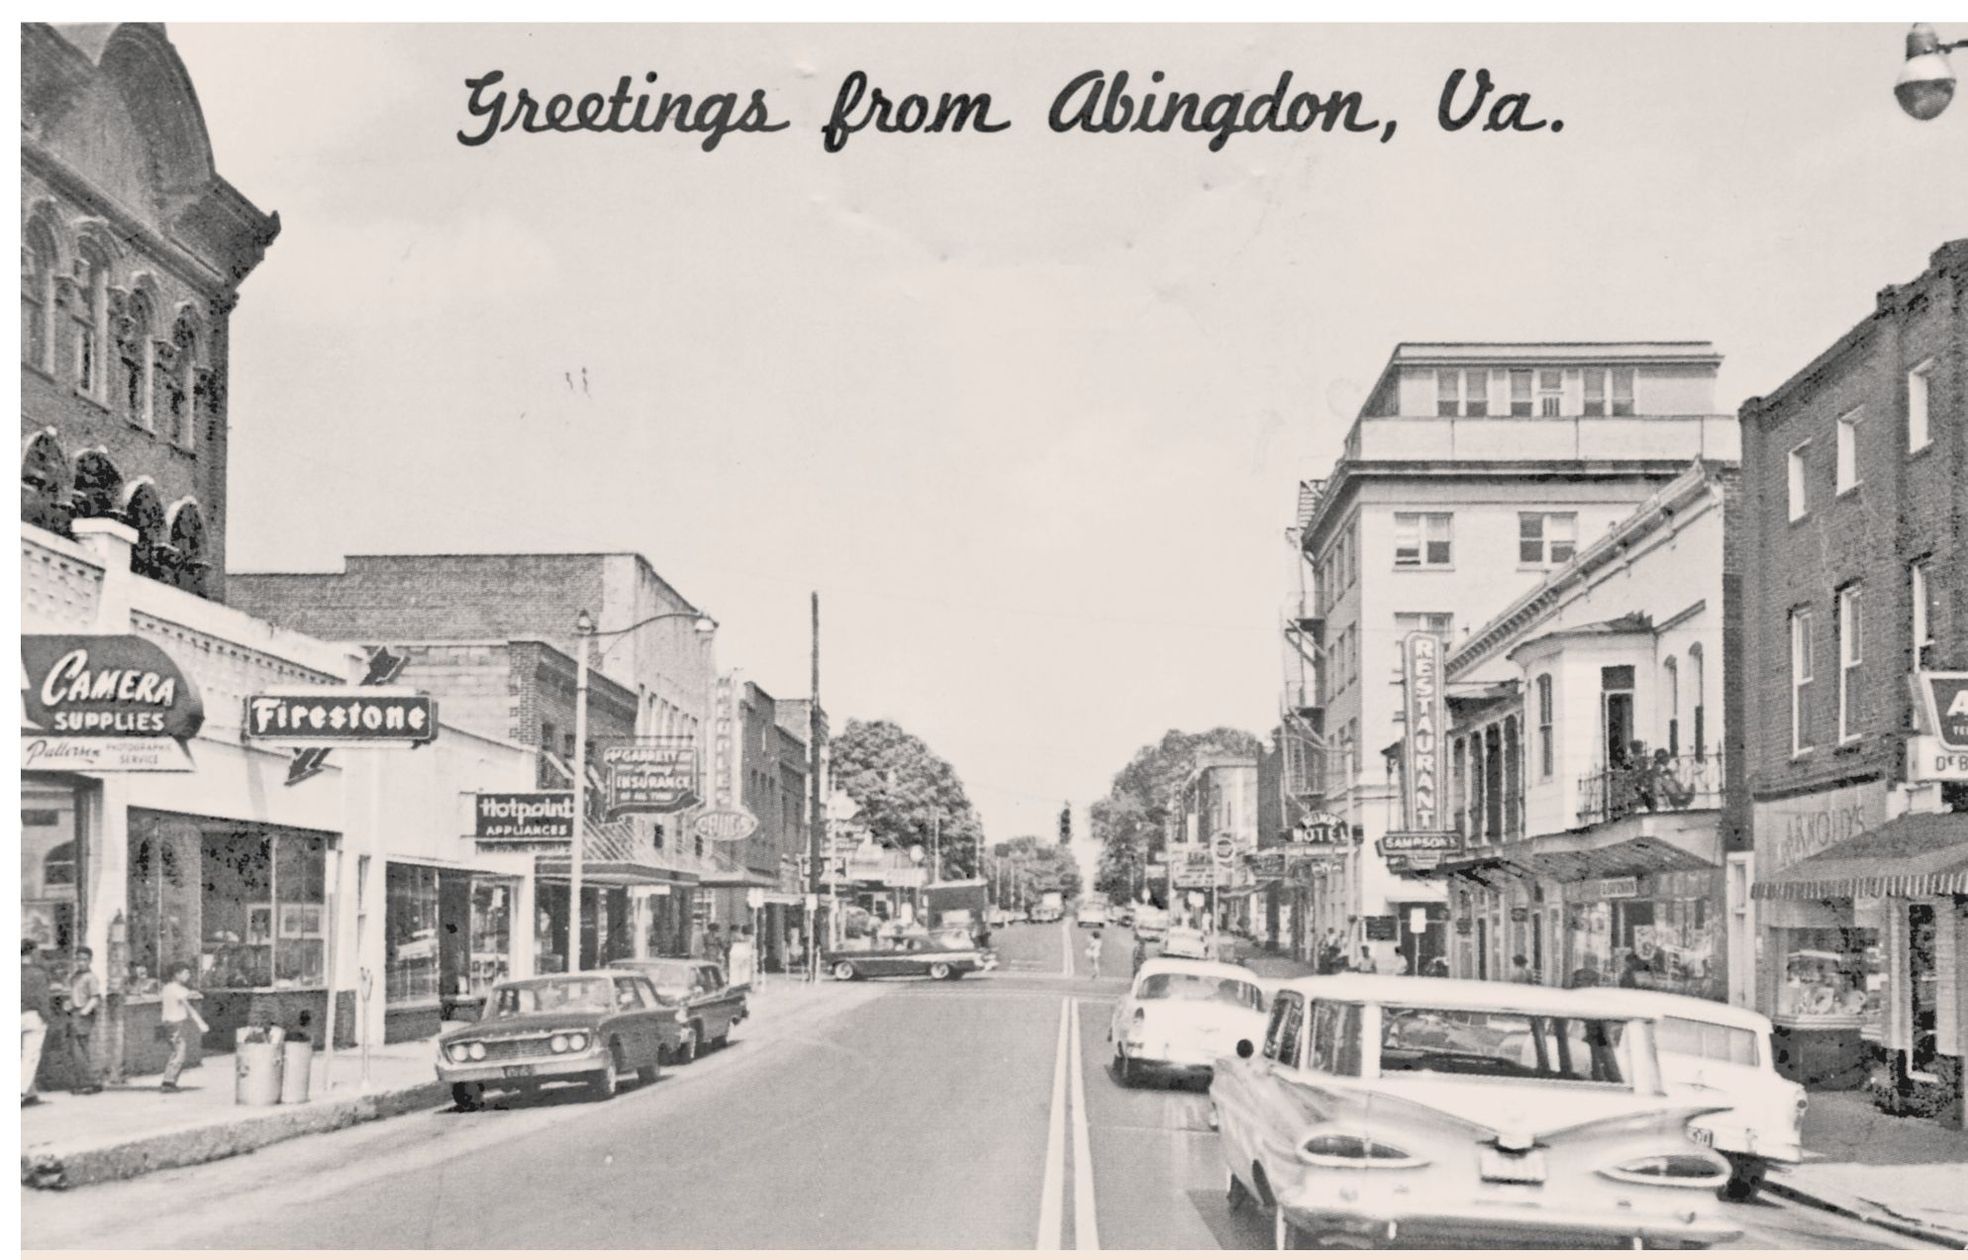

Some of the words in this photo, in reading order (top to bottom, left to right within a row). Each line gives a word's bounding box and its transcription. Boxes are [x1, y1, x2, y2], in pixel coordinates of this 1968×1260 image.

[41, 648, 176, 706] CAMERA
[54, 711, 166, 731] SUPPLIES
[251, 698, 427, 734] Firestone
[1415, 640, 1433, 828] RESTAURANT
[119, 754, 159, 765] SERVICE
[616, 775, 692, 789] INSURANCE
[479, 797, 575, 826] Hotpoint
[485, 824, 567, 837] APPLIANCES
